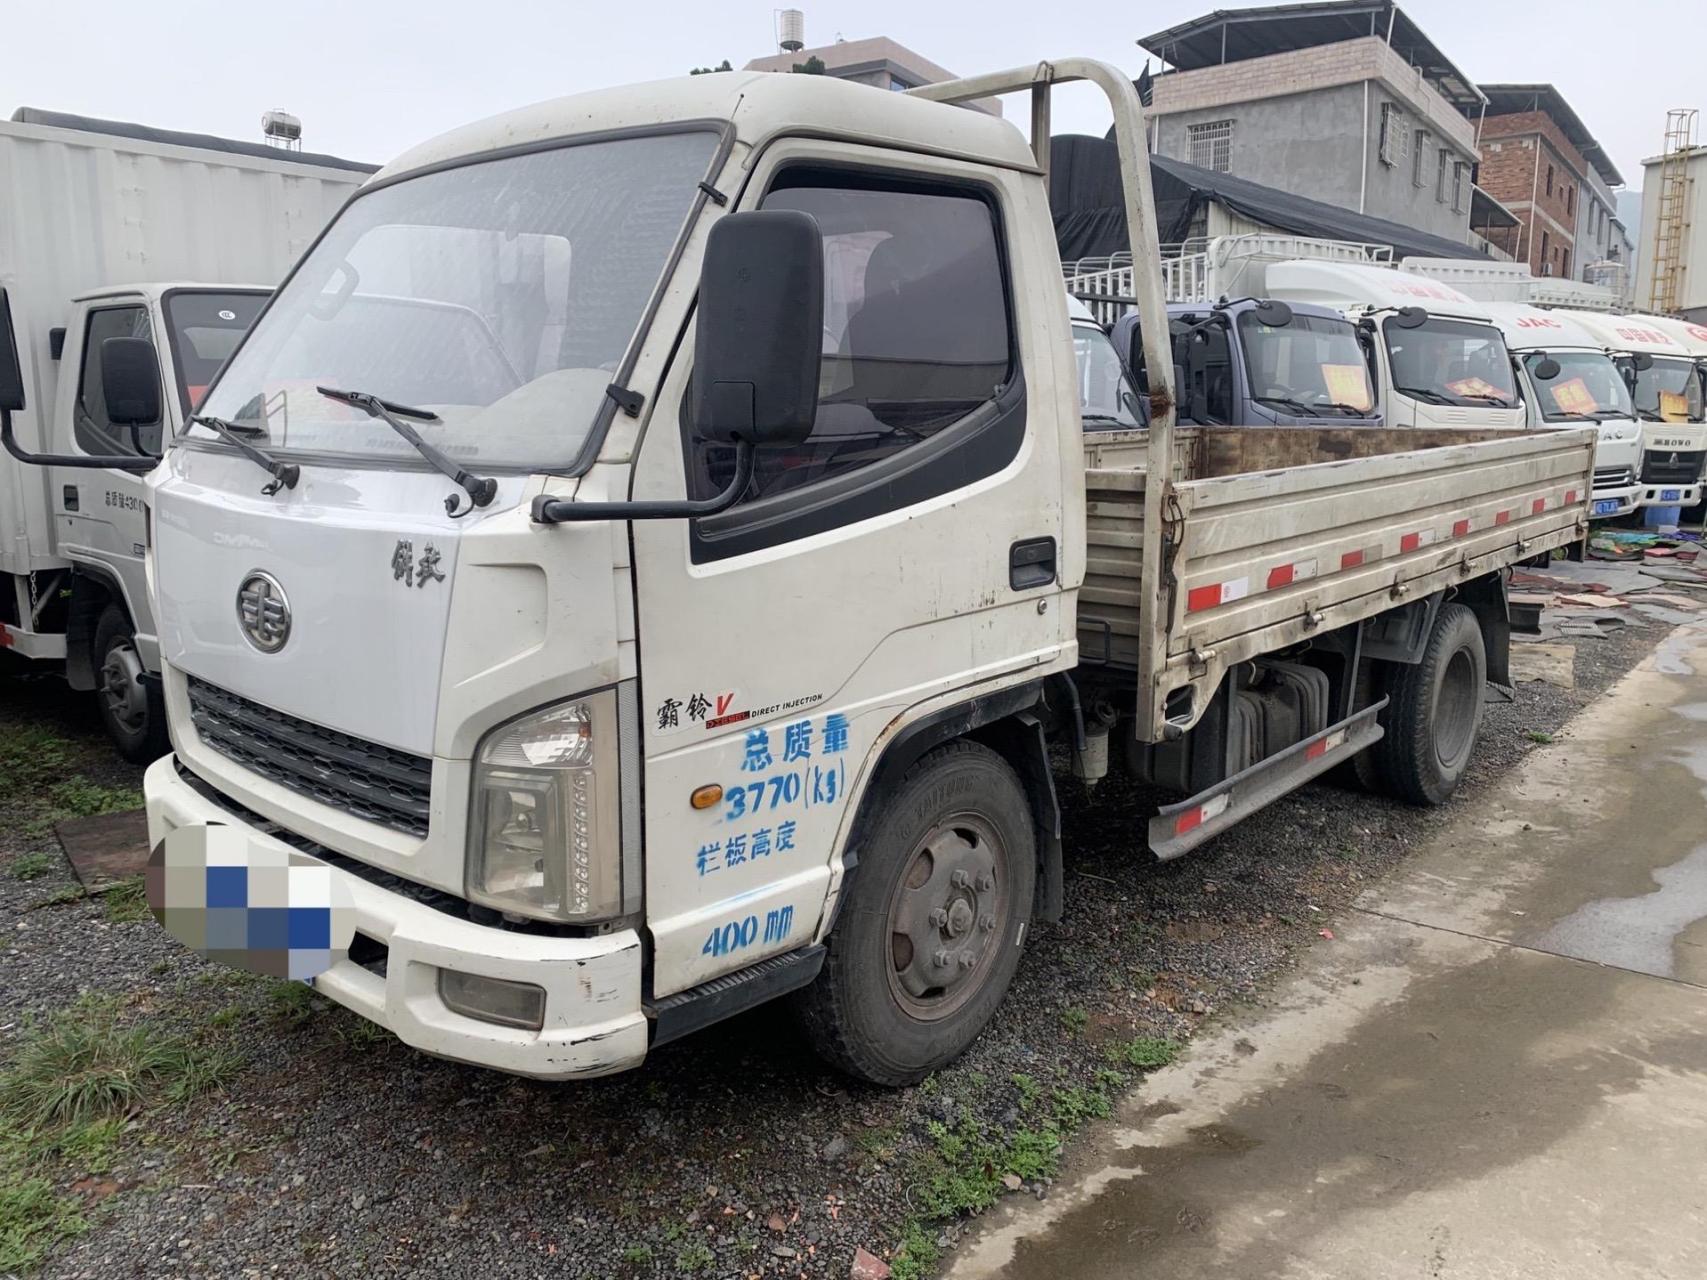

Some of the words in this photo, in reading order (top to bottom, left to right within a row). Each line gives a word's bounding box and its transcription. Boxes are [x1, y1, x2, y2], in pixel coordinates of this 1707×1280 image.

[1516, 317, 1562, 328] JAC
[1603, 431, 1623, 441] AC
[1664, 439, 1692, 447] HOWO
[751, 704, 781, 718] DIRECT
[782, 693, 823, 710] INJECTION
[740, 713, 850, 772] 总质量
[696, 820, 797, 876] 栏板高度
[702, 915, 759, 958] 400
